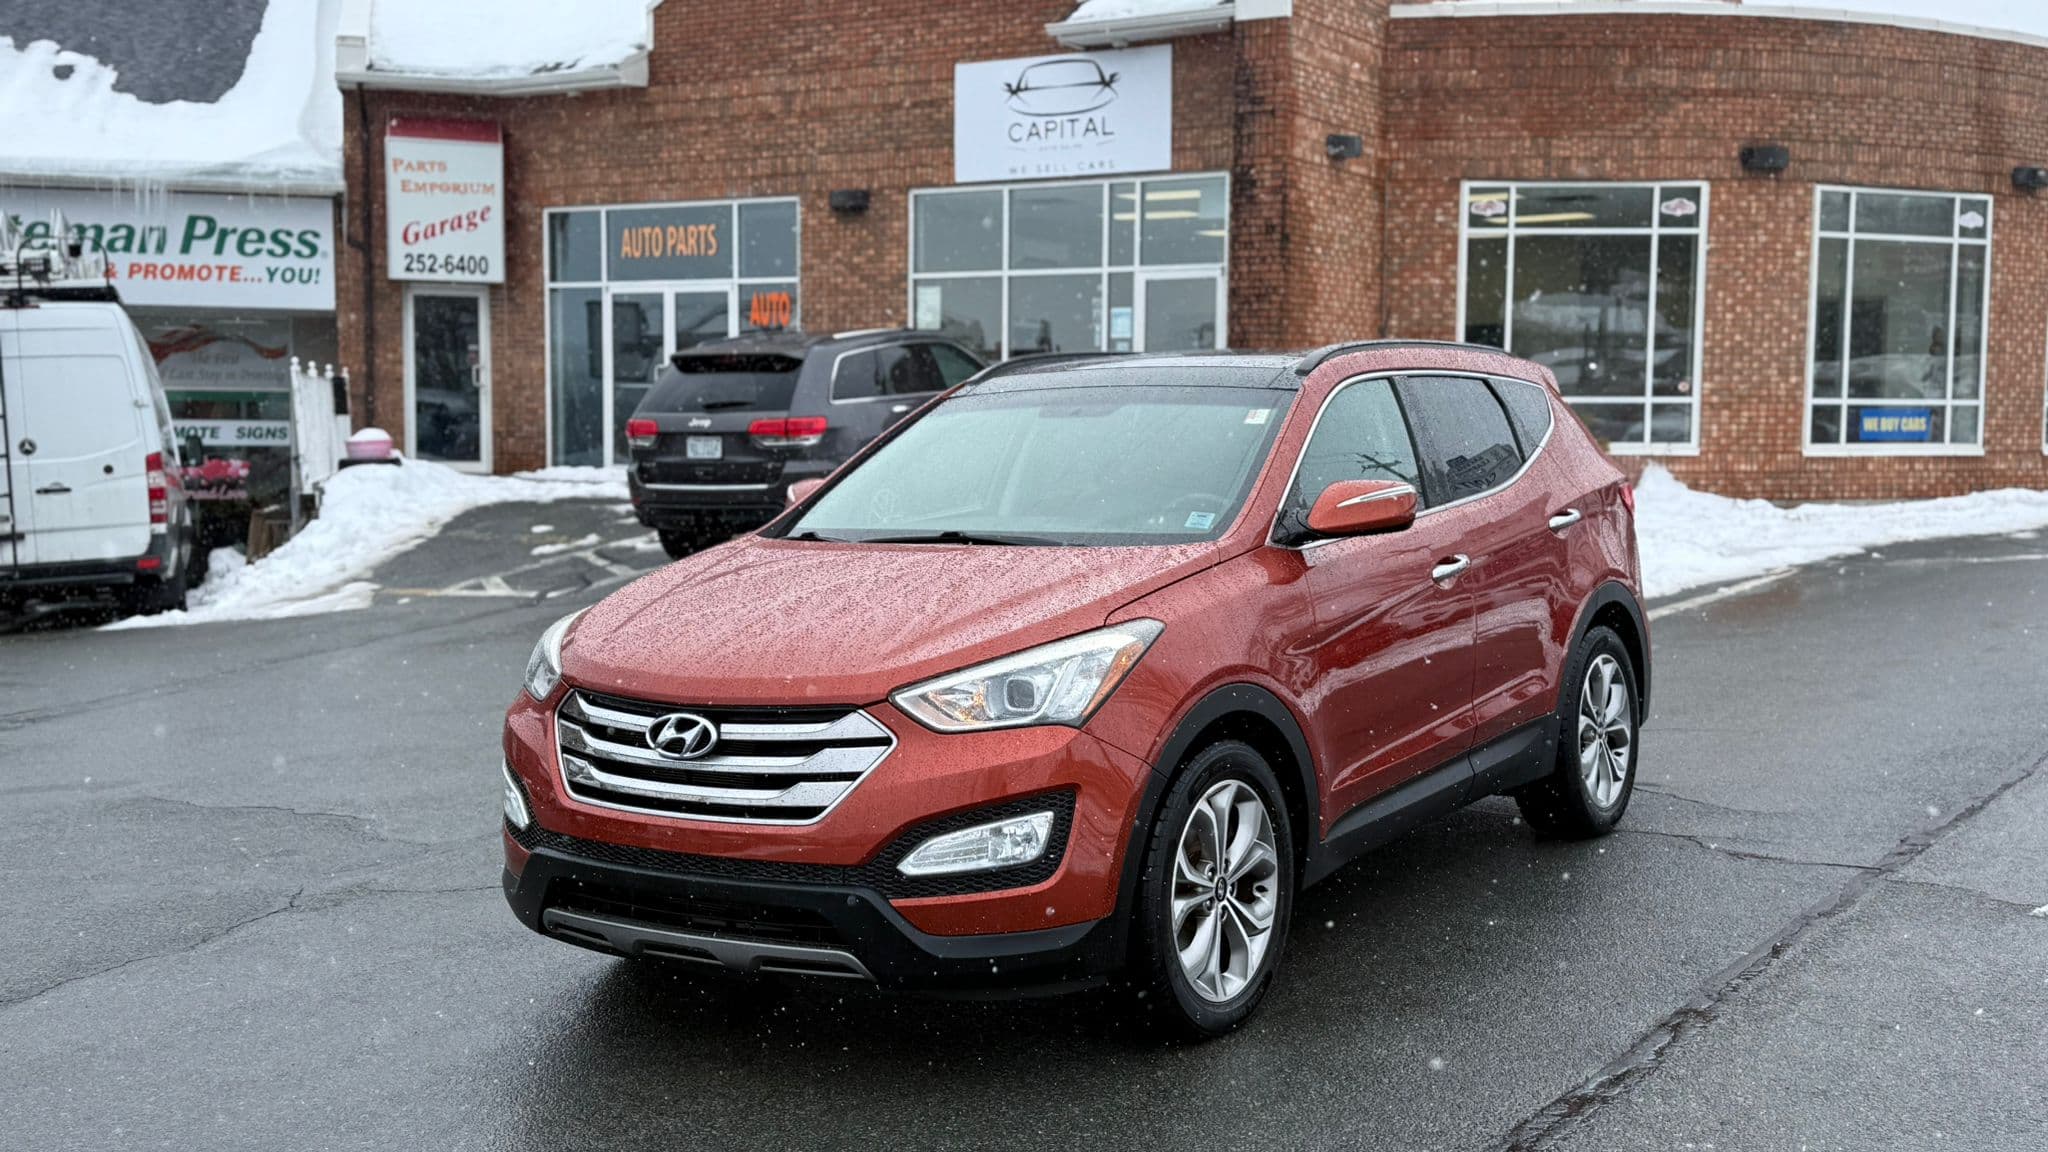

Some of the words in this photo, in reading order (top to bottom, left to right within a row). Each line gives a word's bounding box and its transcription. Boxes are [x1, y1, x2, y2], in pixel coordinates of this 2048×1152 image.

[1008, 116, 1115, 143] CAPITAL
[392, 158, 448, 174] PARTS
[400, 179, 496, 196] EMPORIUM
[179, 214, 322, 260] Press
[402, 205, 491, 246] Garage
[621, 226, 664, 259] AUTO
[667, 223, 719, 257] PARTS
[404, 252, 489, 275] 252-6400
[749, 290, 791, 327] AUTO
[235, 426, 288, 439] SIGNS
[1863, 416, 1878, 432] WE
[1881, 416, 1899, 432] BUY
[1901, 416, 1927, 432] CARS
